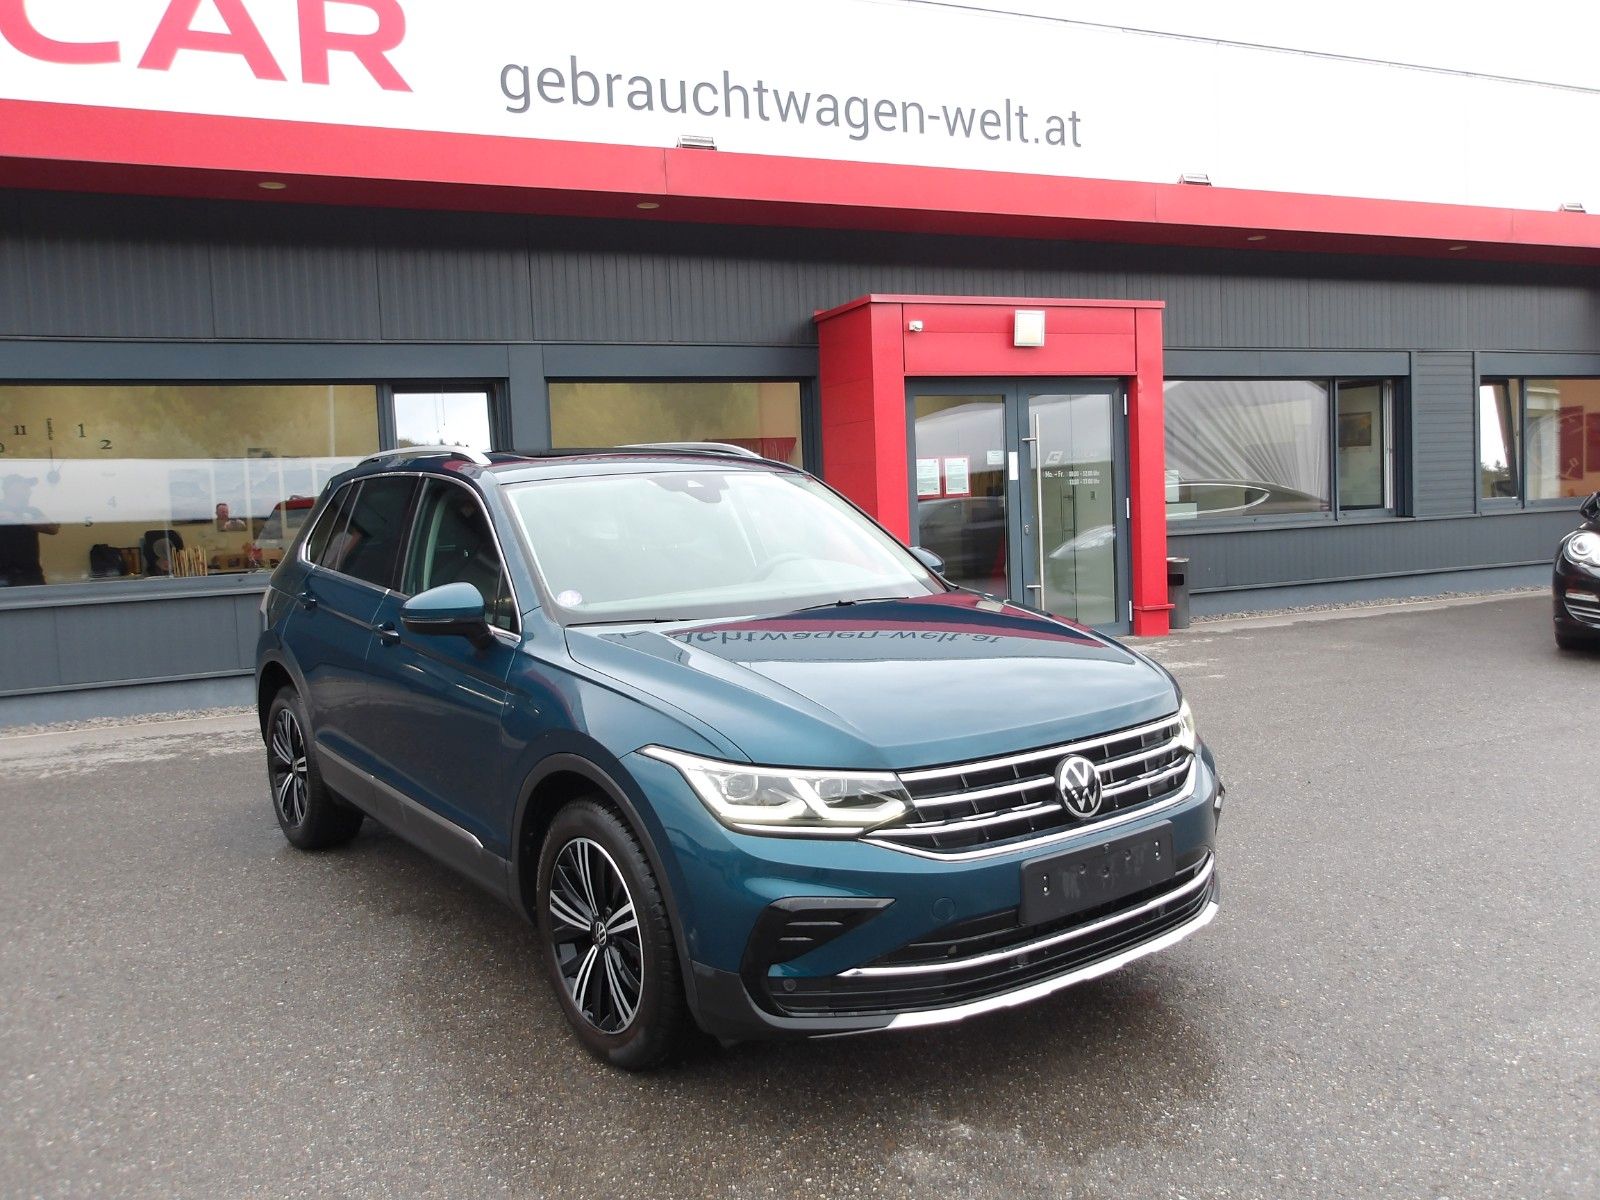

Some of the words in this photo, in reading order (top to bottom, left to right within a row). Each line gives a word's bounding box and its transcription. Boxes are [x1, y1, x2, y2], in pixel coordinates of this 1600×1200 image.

[0, 0, 411, 92] CAR
[500, 54, 1082, 148] gebrauchtwagen-welt.at
[78, 423, 87, 438] 1
[99, 439, 113, 450] 2
